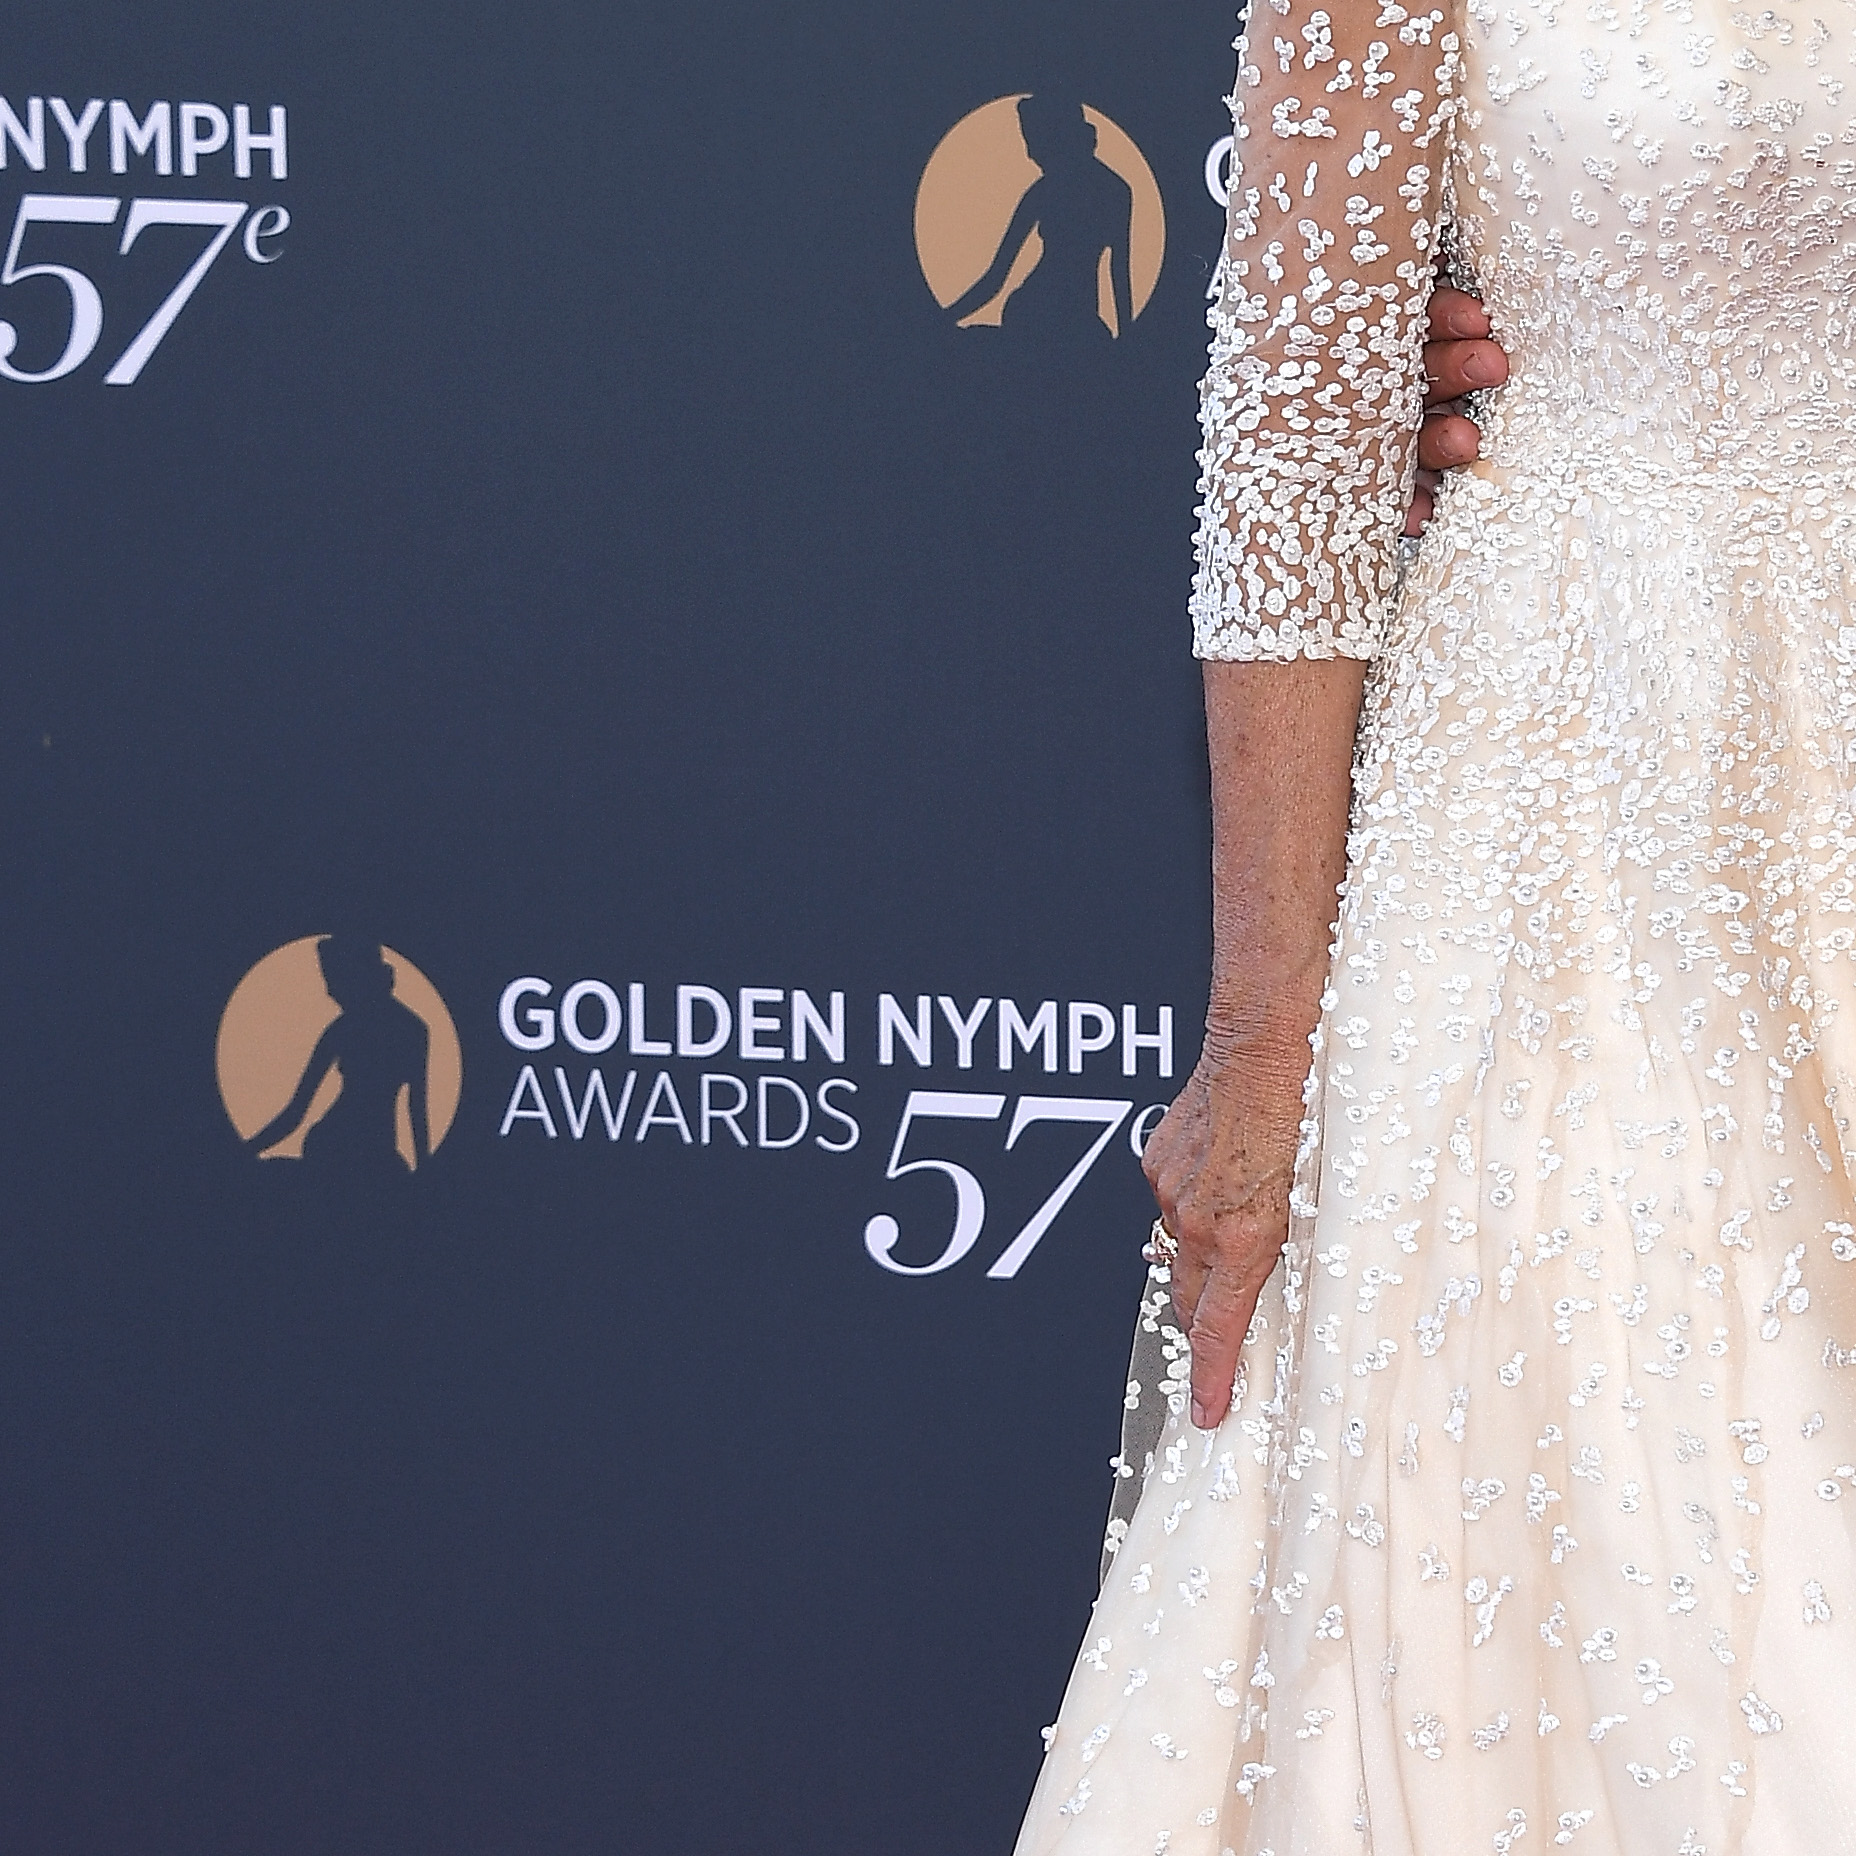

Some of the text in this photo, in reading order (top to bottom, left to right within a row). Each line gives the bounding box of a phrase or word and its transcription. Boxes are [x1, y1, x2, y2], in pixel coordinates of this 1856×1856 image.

[0, 96, 288, 180] NYMPH
[498, 977, 1173, 1078] GOLDEN NYMPH
[500, 1065, 860, 1152] AWARDS
